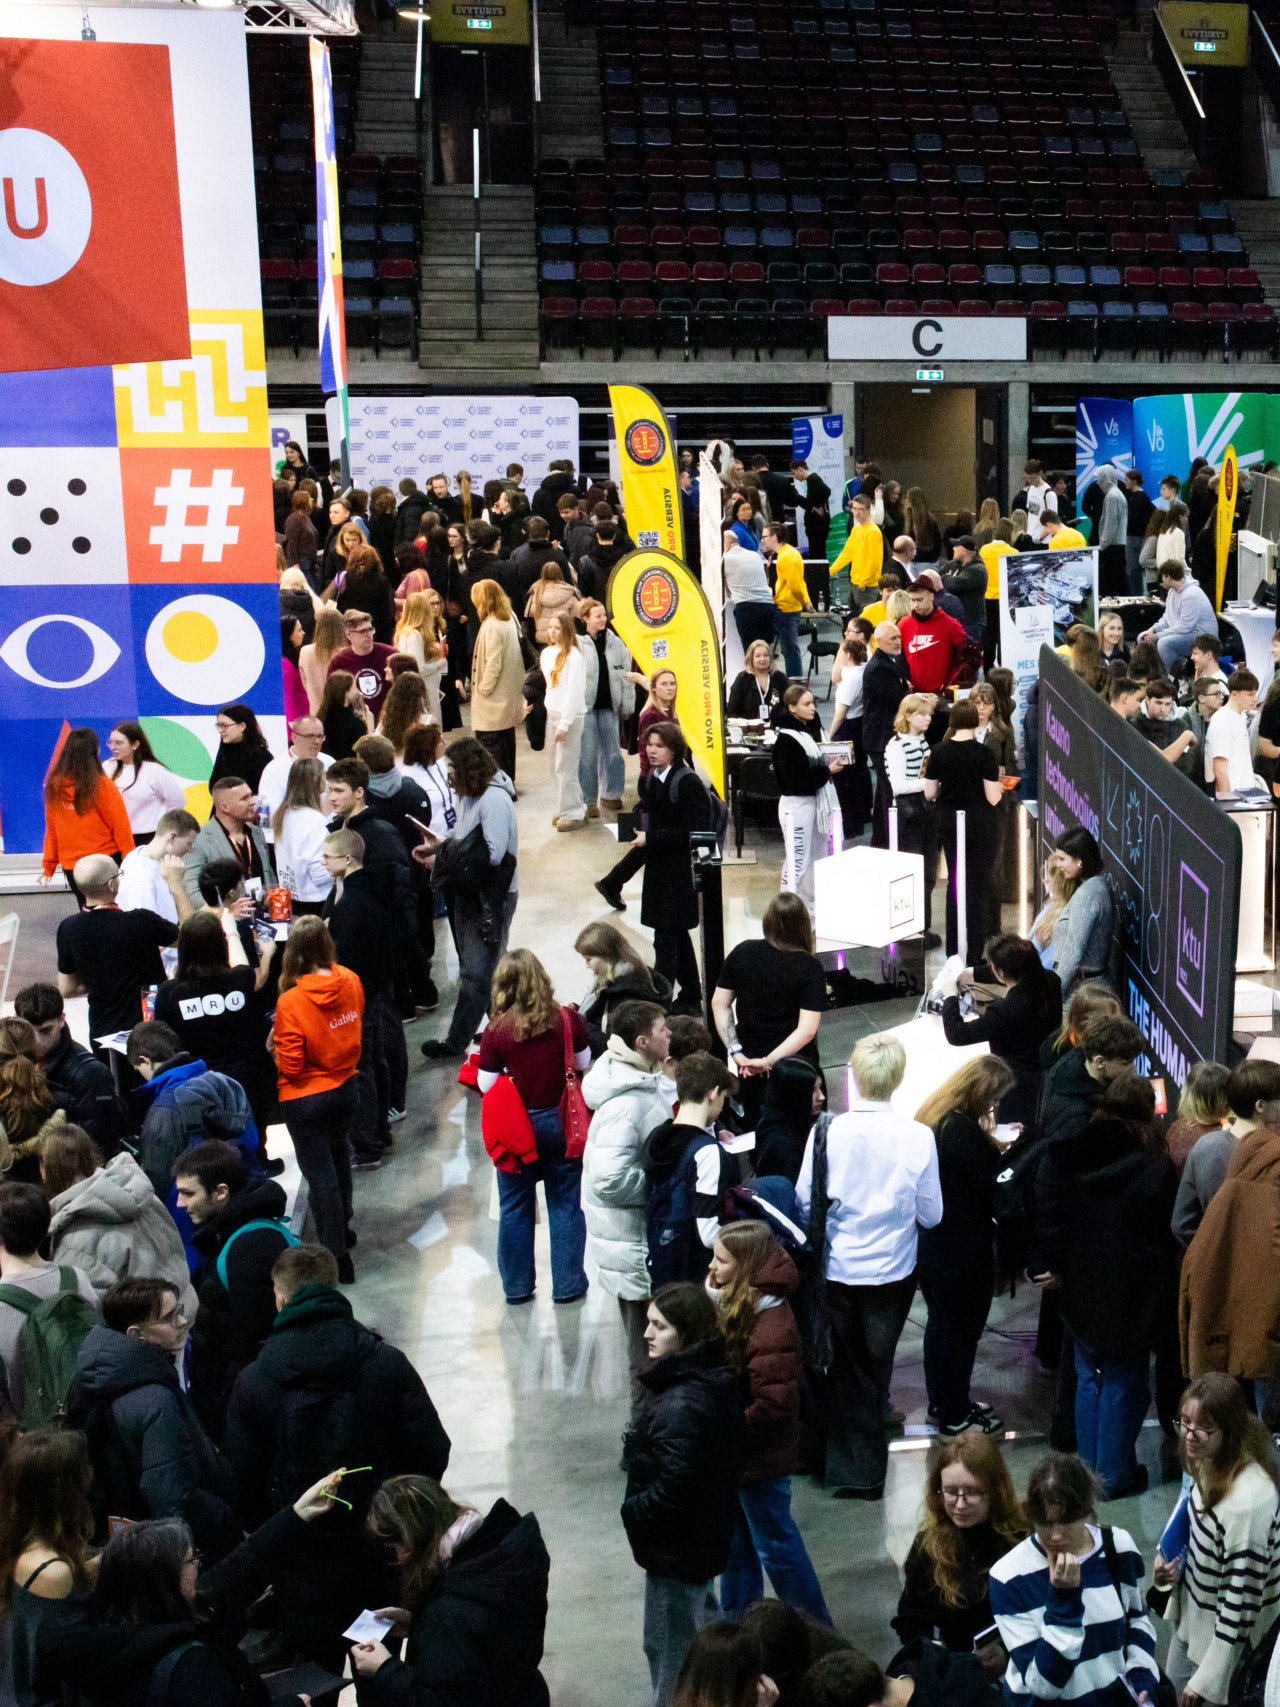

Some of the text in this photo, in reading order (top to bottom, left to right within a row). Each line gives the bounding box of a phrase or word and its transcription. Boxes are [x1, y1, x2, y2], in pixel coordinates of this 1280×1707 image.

[911, 319, 944, 358] C
[1017, 659, 1035, 670] MES
[1045, 700, 1071, 757] Kauno
[1045, 750, 1099, 843] technologijos
[894, 896, 911, 913] ktu
[1182, 916, 1201, 971] ktu
[186, 996, 240, 1014] MRU
[329, 1010, 358, 1029] Gabija
[1128, 978, 1150, 1041] THE
